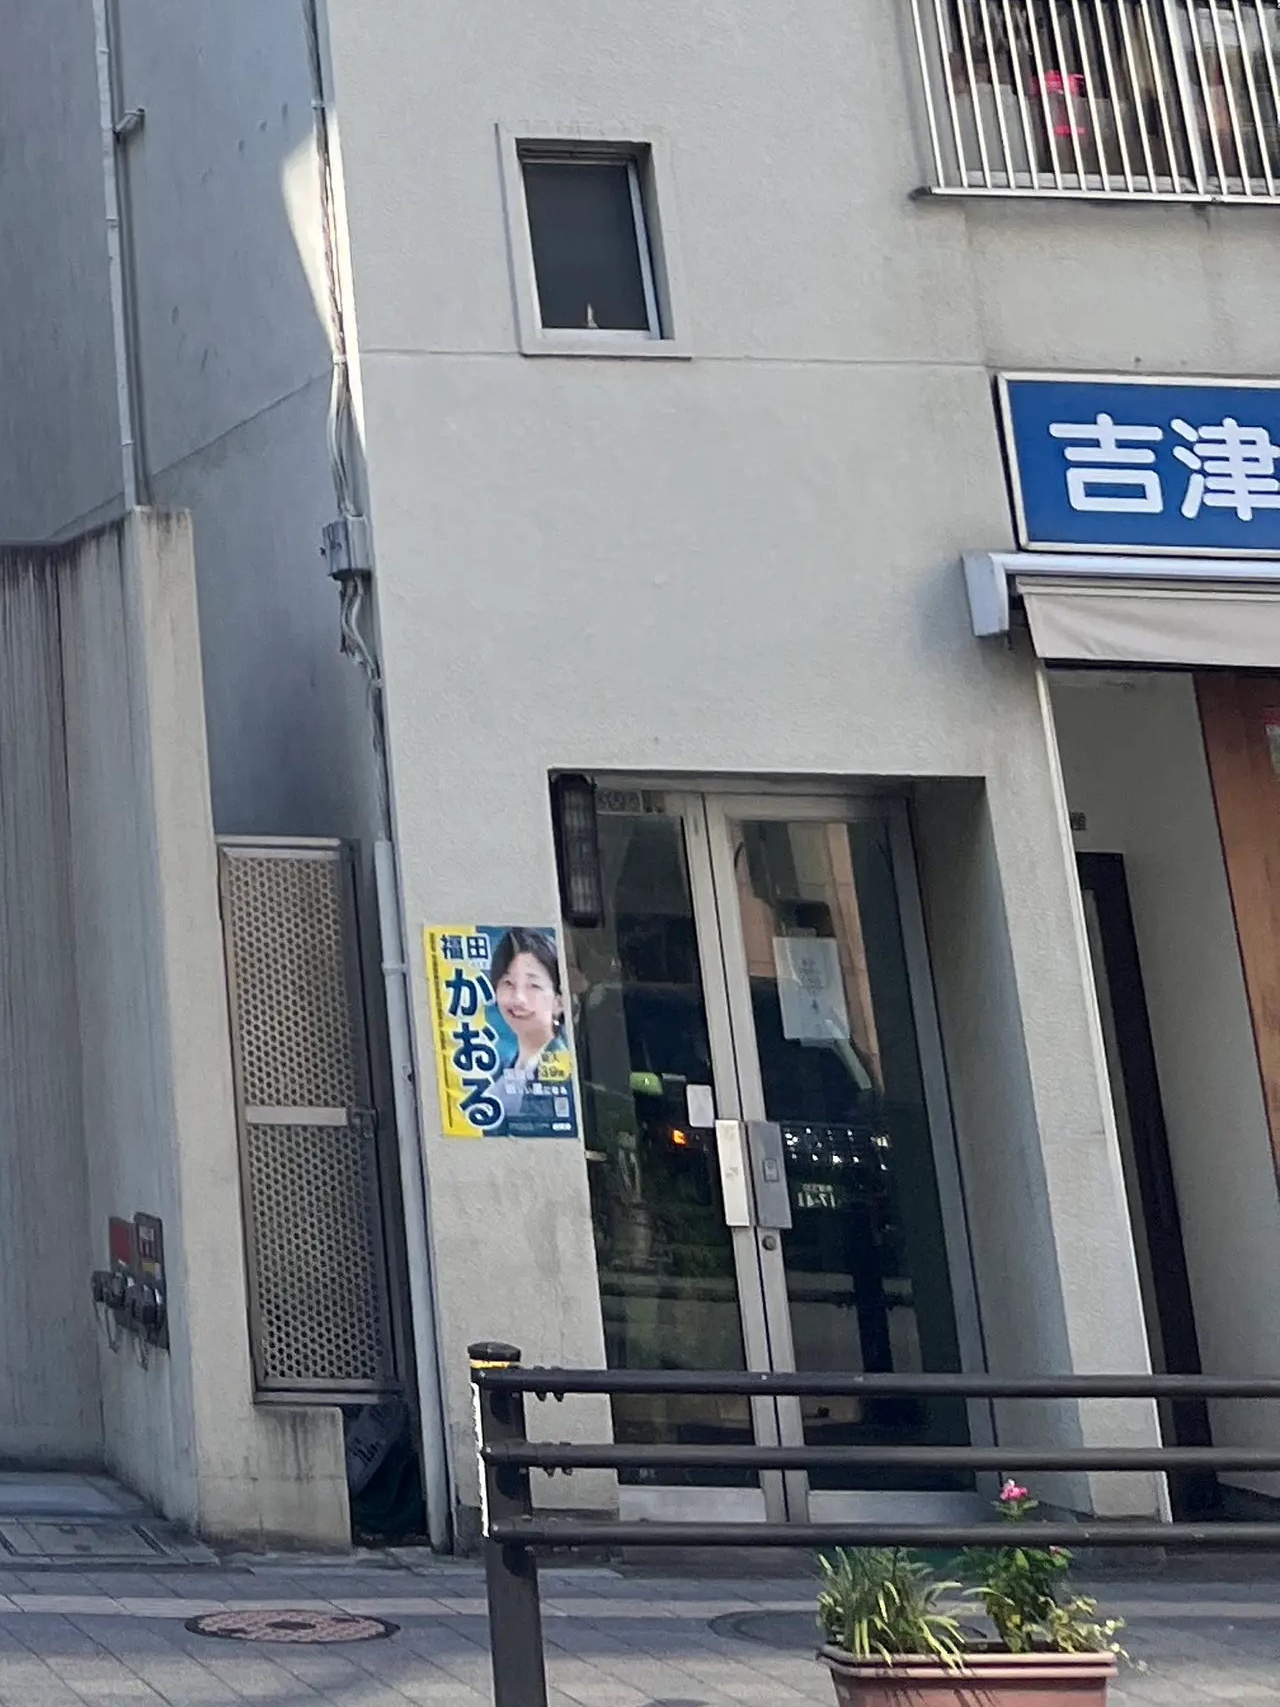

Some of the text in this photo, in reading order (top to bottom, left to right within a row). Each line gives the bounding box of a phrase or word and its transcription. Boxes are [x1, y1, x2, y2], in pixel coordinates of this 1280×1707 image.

[1048, 411, 1280, 522] 吉津
[440, 934, 490, 960] 福田
[445, 967, 504, 1127] かおる
